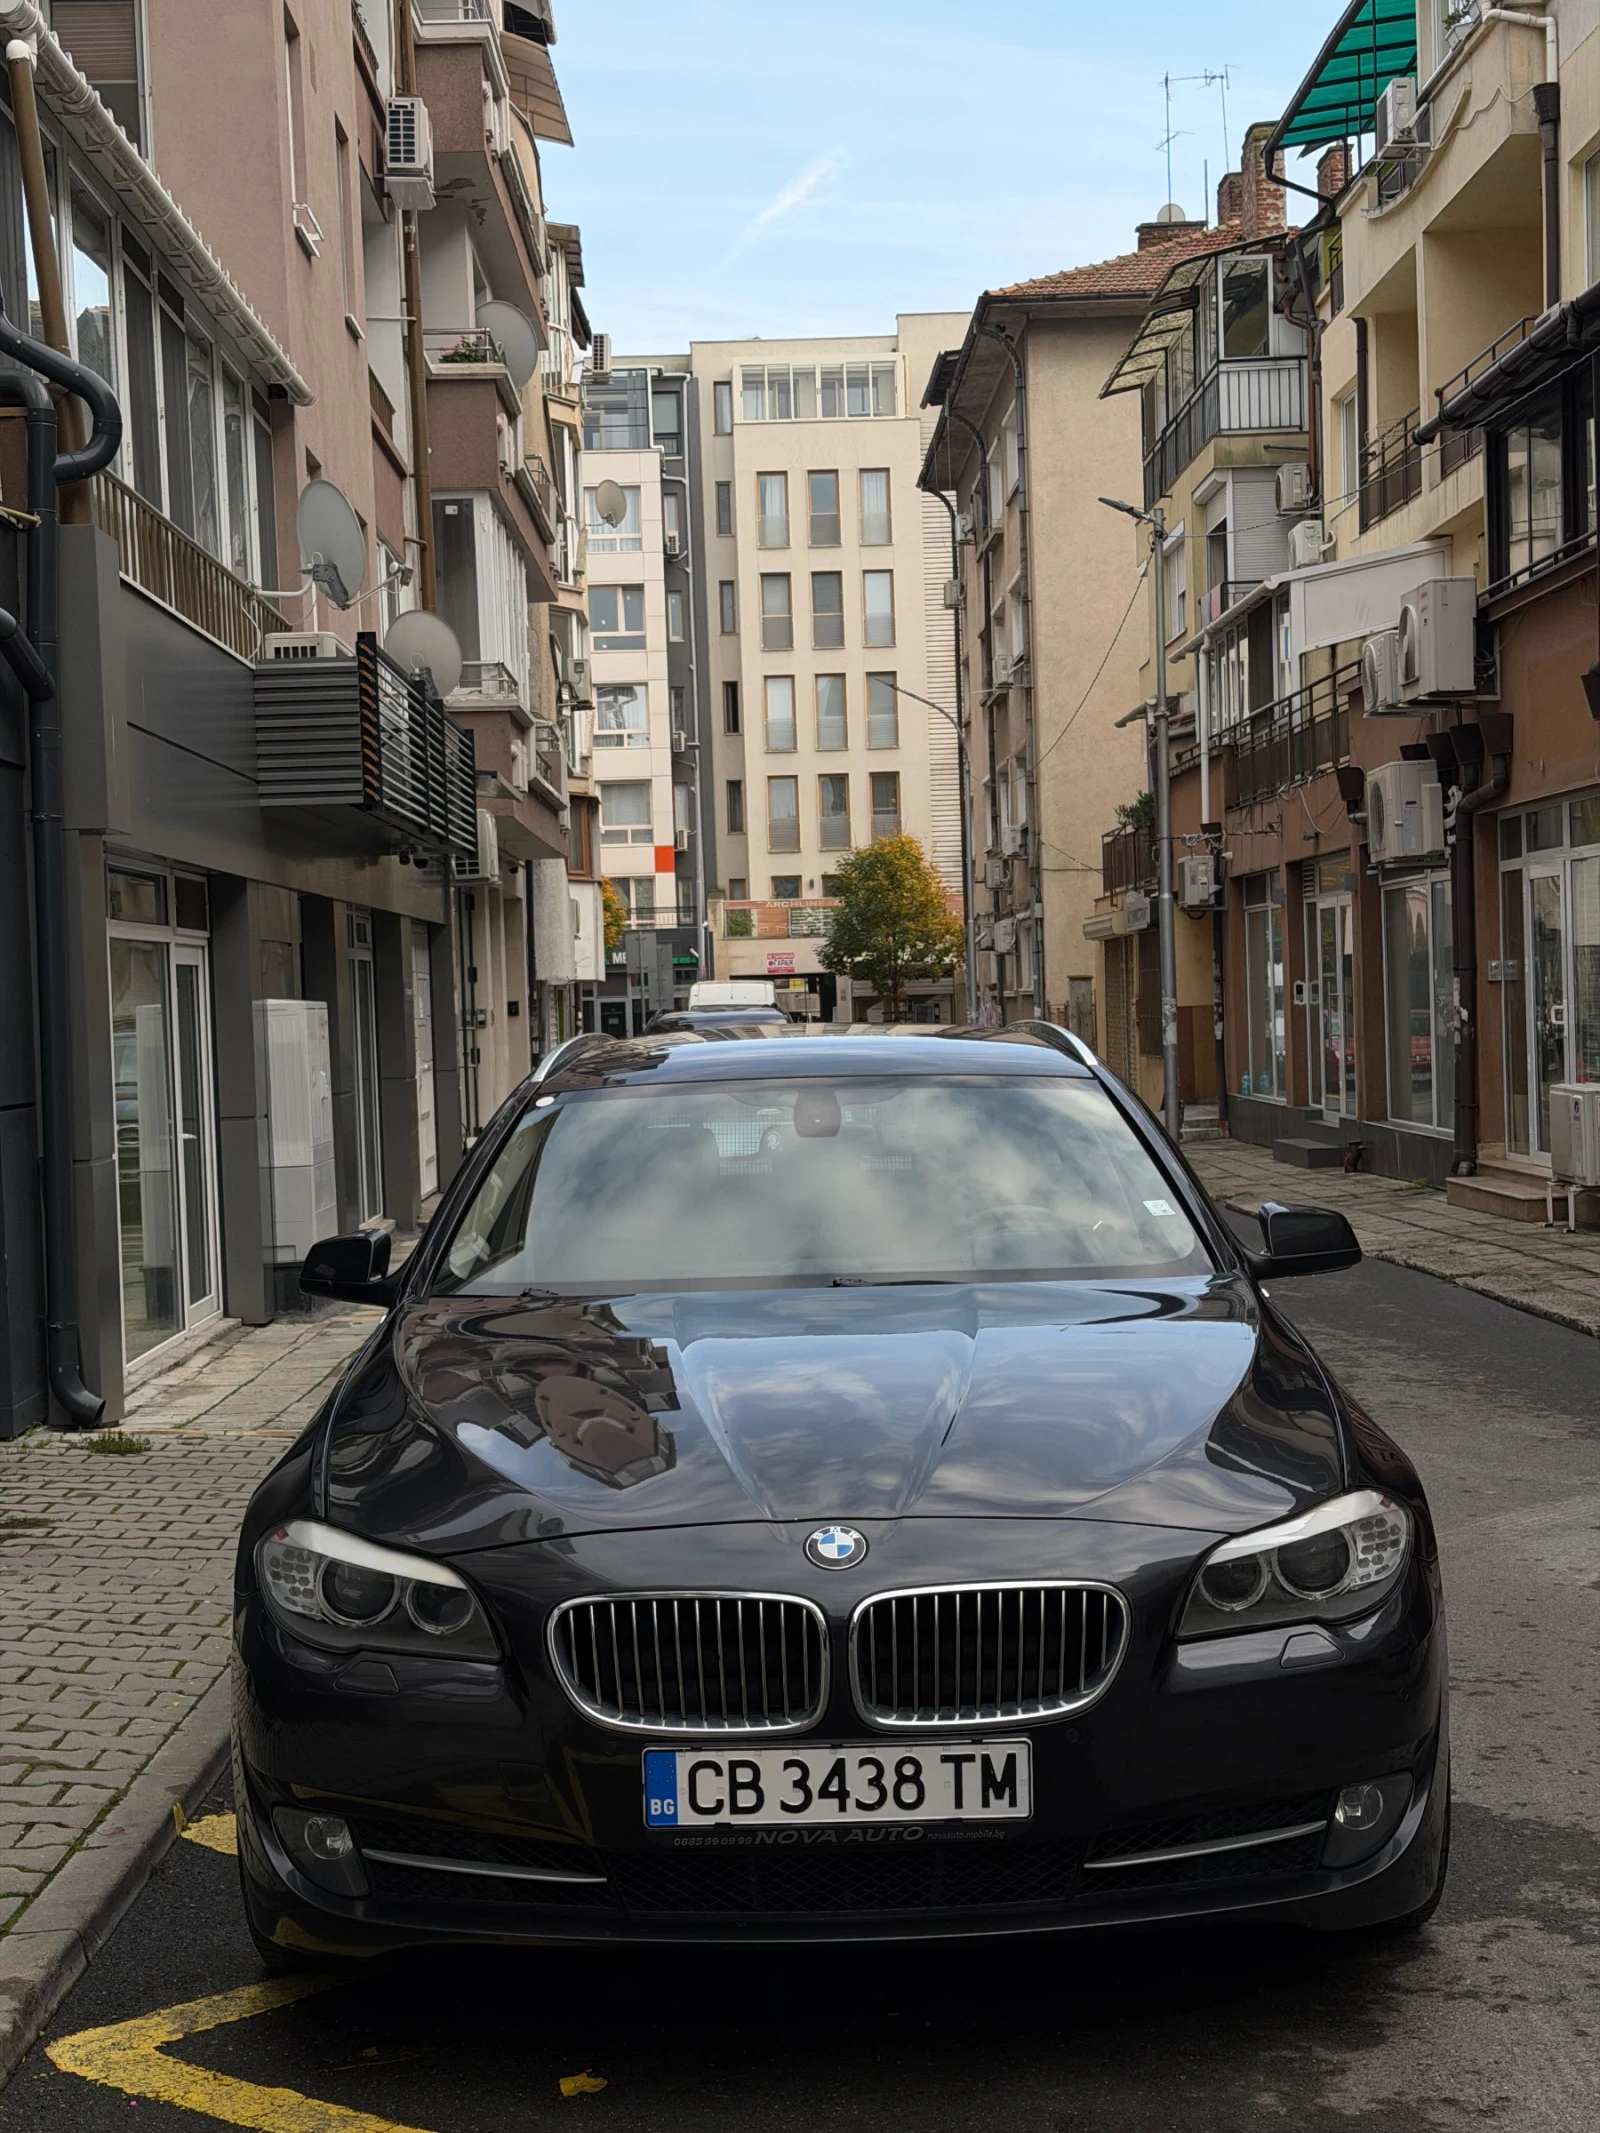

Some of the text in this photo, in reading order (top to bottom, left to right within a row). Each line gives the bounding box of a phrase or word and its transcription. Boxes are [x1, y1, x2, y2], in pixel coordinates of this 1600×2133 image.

[812, 1526, 861, 1540] BMW
[688, 1752, 1017, 1815] CB 3438 TM
[650, 1798, 675, 1816] BG
[673, 1826, 1005, 1846] 0885 99 09 99 NOVA AUTO novaauto.mobile.bg
